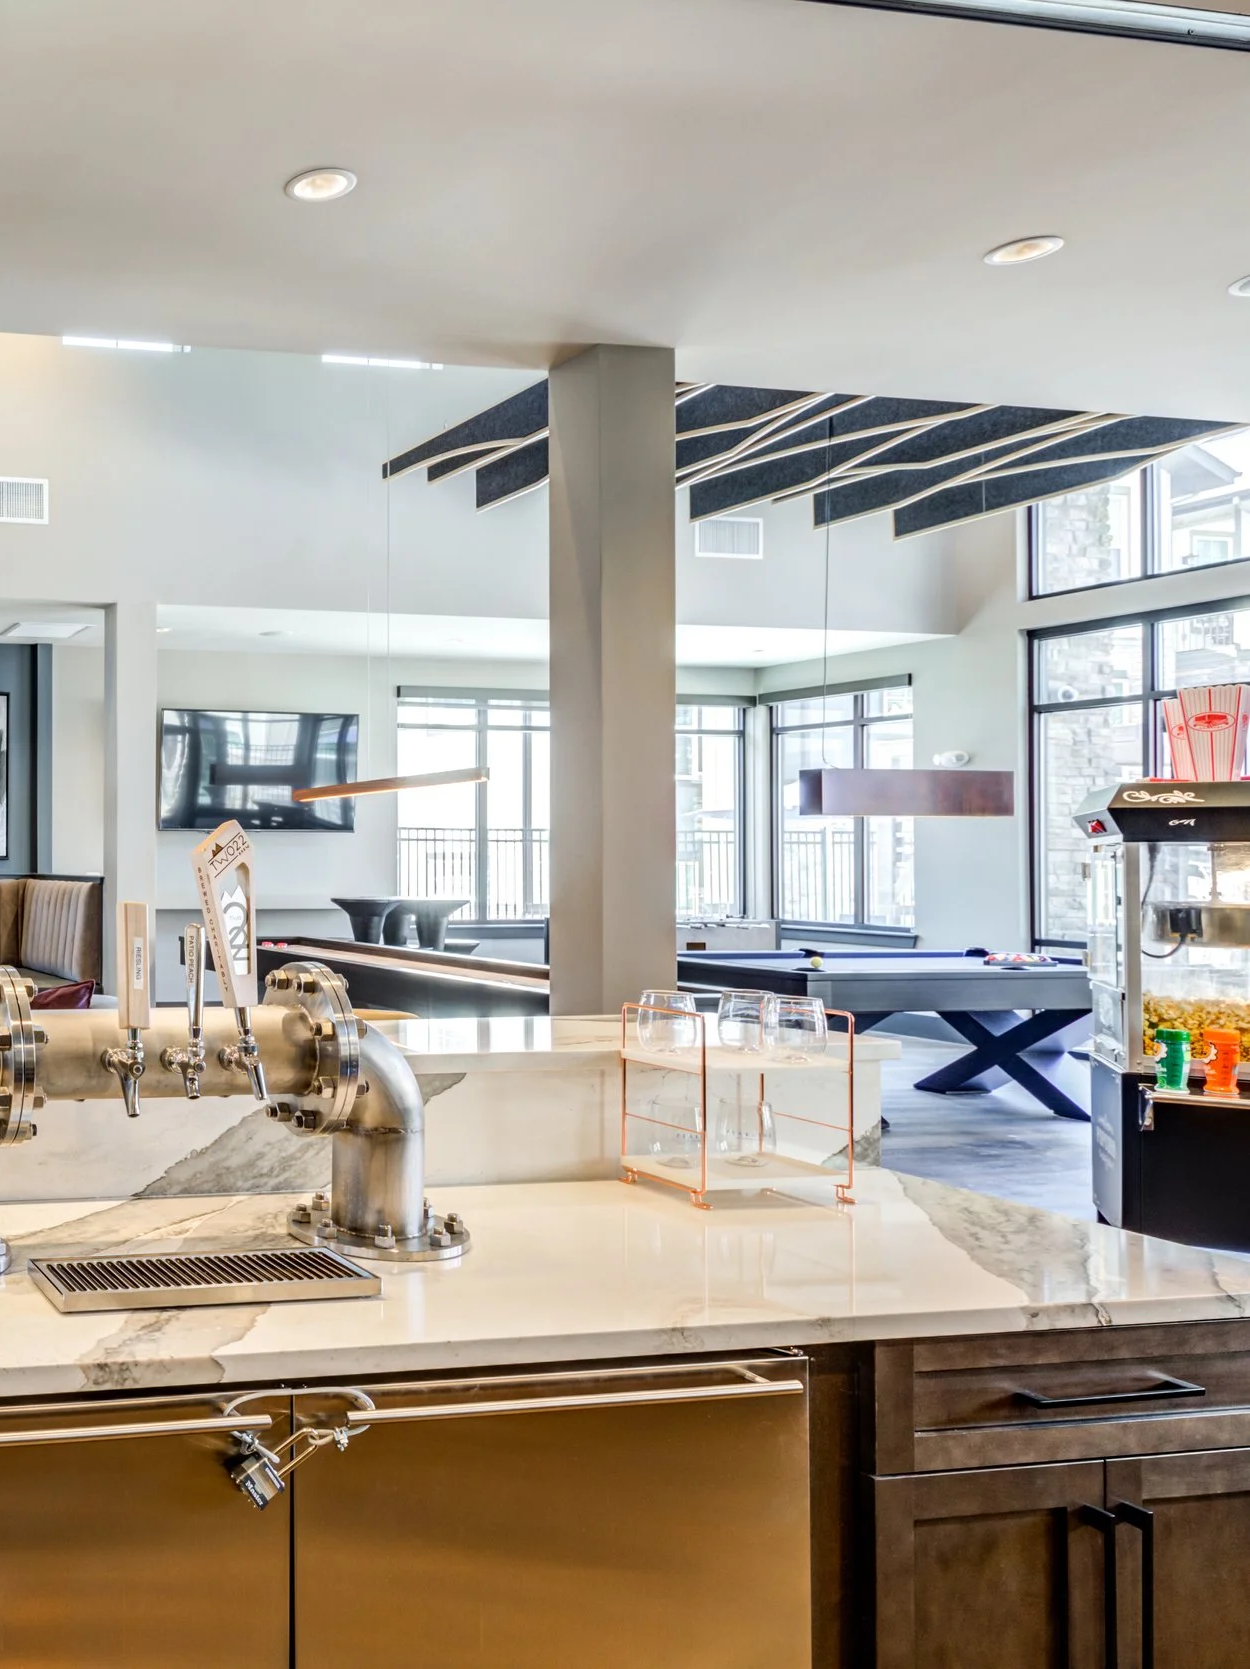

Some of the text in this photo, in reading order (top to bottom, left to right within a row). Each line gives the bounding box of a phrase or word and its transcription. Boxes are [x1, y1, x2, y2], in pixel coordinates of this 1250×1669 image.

[198, 866, 229, 992] BREWED CHARITABLY
[245, 1480, 264, 1506] Master
